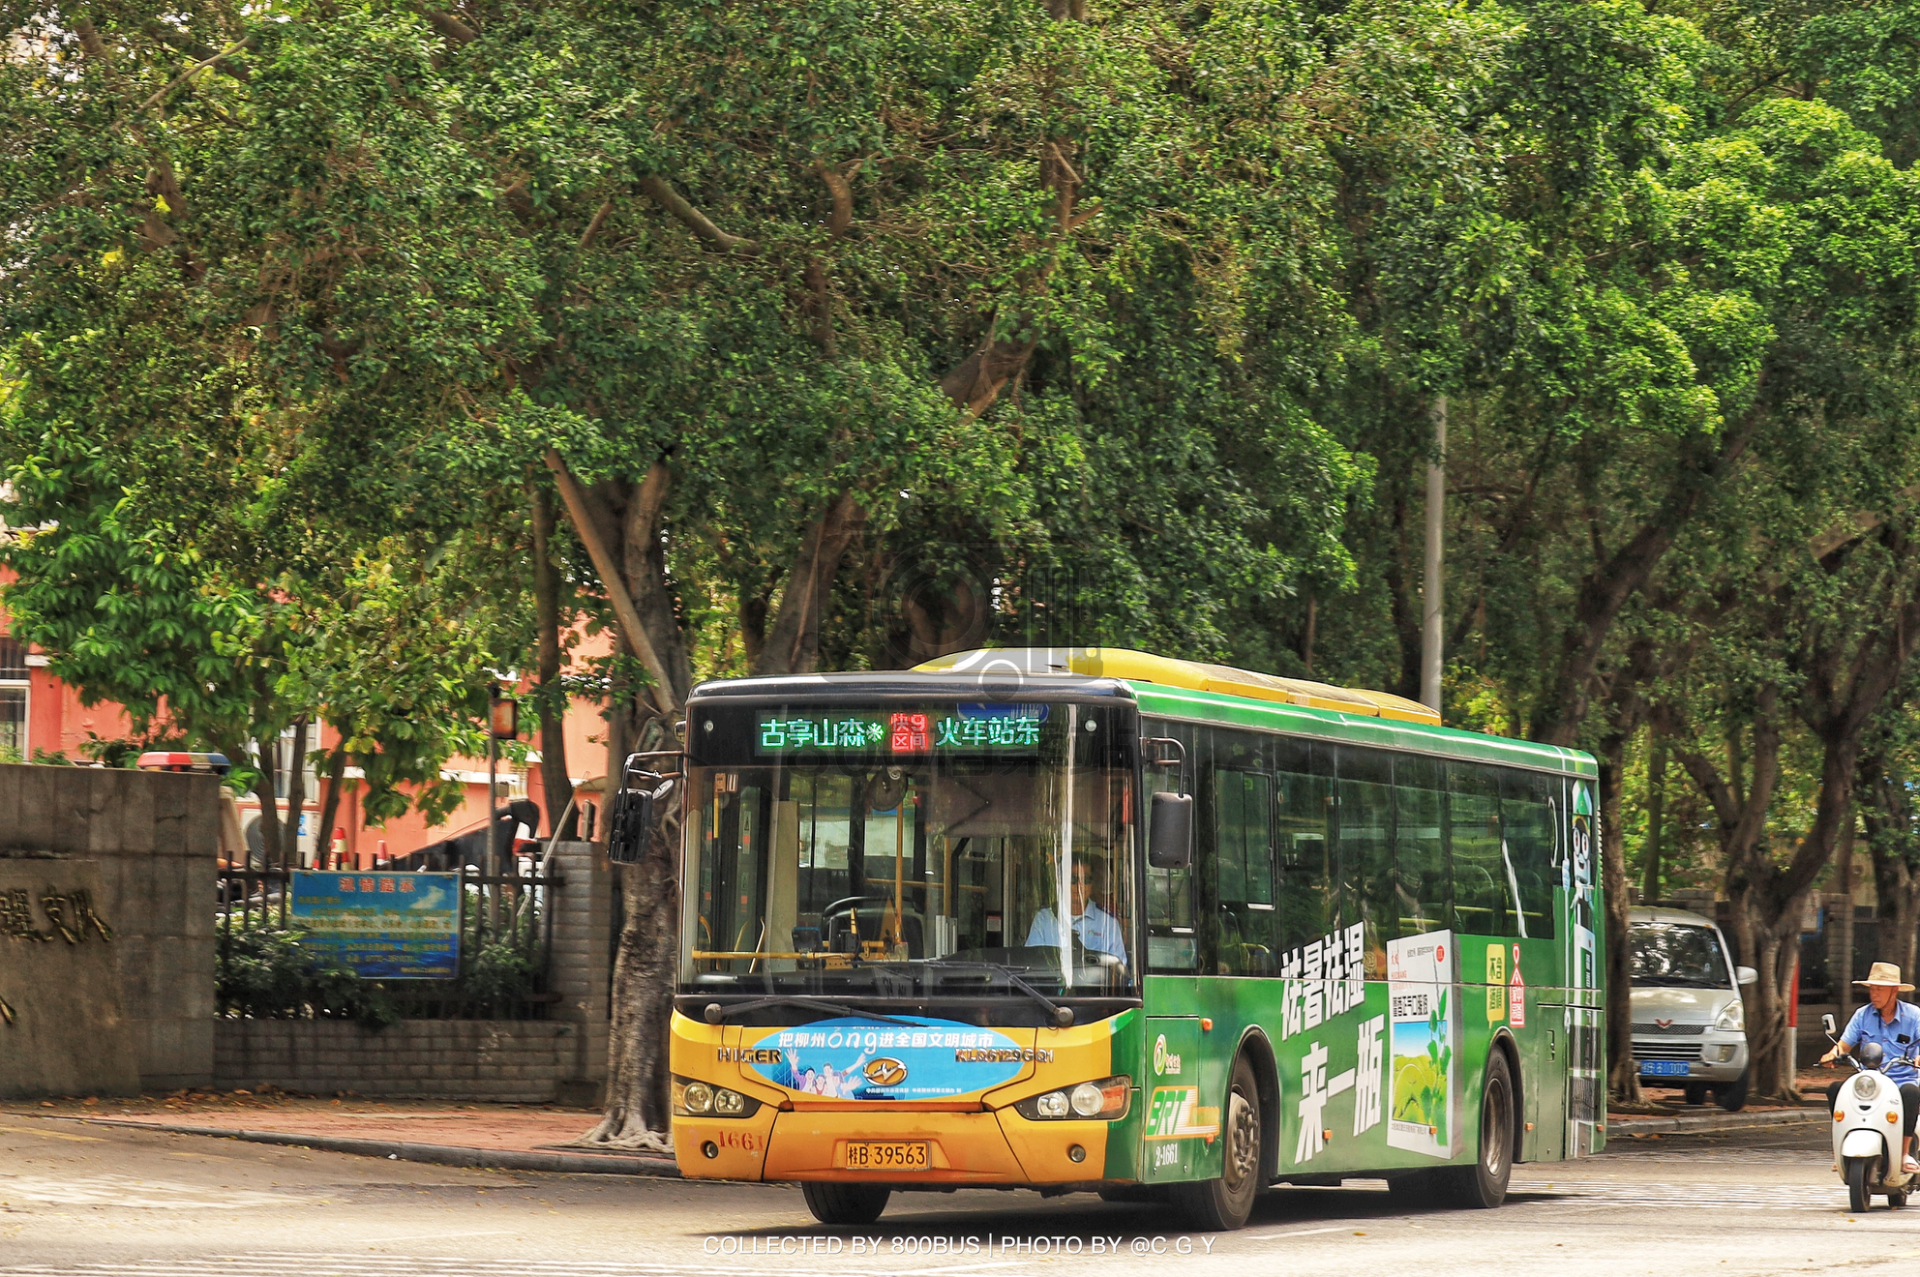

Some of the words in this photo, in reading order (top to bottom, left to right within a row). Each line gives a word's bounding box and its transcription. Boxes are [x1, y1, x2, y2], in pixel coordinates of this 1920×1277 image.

[891, 732, 926, 750] 区间
[936, 716, 1040, 747] 火车站东
[1281, 921, 1365, 1042] 祛暑祛湿
[717, 1047, 782, 1063] HIGER
[1294, 1014, 1385, 1165] 来一瓶
[1145, 1089, 1188, 1136] BRT
